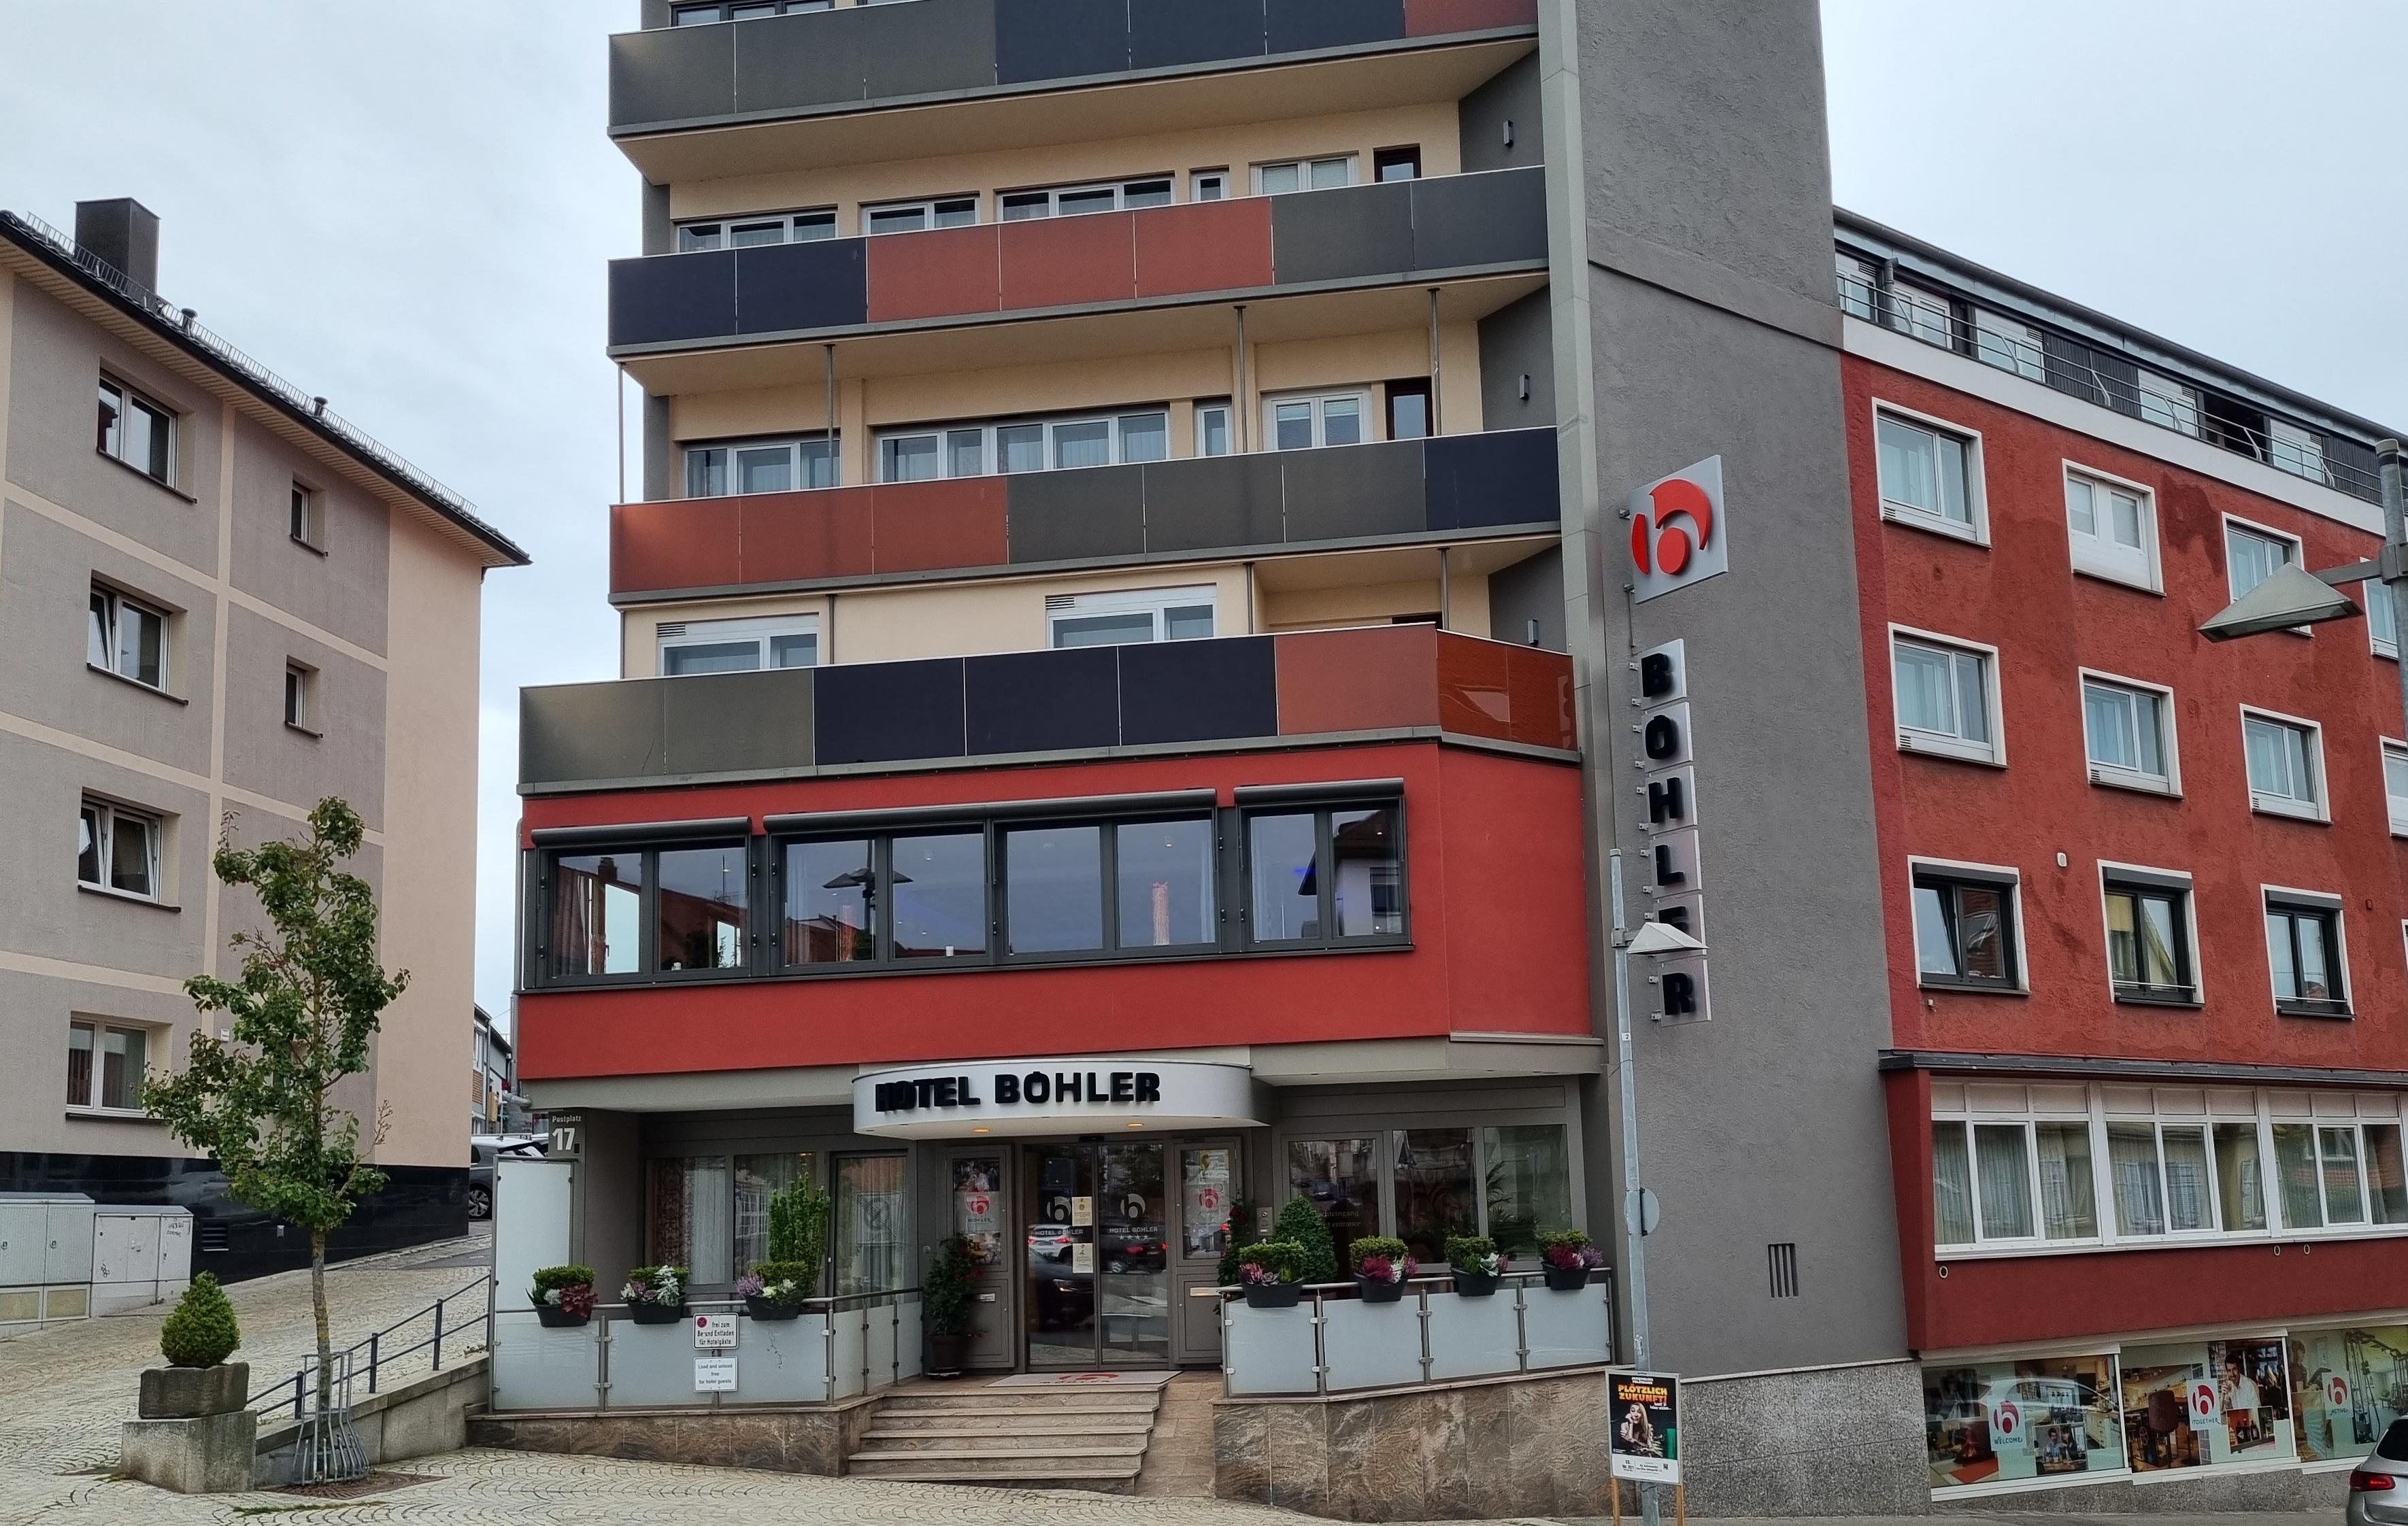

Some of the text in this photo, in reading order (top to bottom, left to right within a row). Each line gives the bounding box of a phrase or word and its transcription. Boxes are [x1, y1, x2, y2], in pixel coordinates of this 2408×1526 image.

[875, 1075, 981, 1112] HOTEL
[552, 1115, 582, 1123] Postplatz
[552, 1127, 575, 1151] 17
[1618, 1383, 1668, 1395] PLÖTZLICH
[1619, 1392, 1667, 1404] ZUKUNFT!
